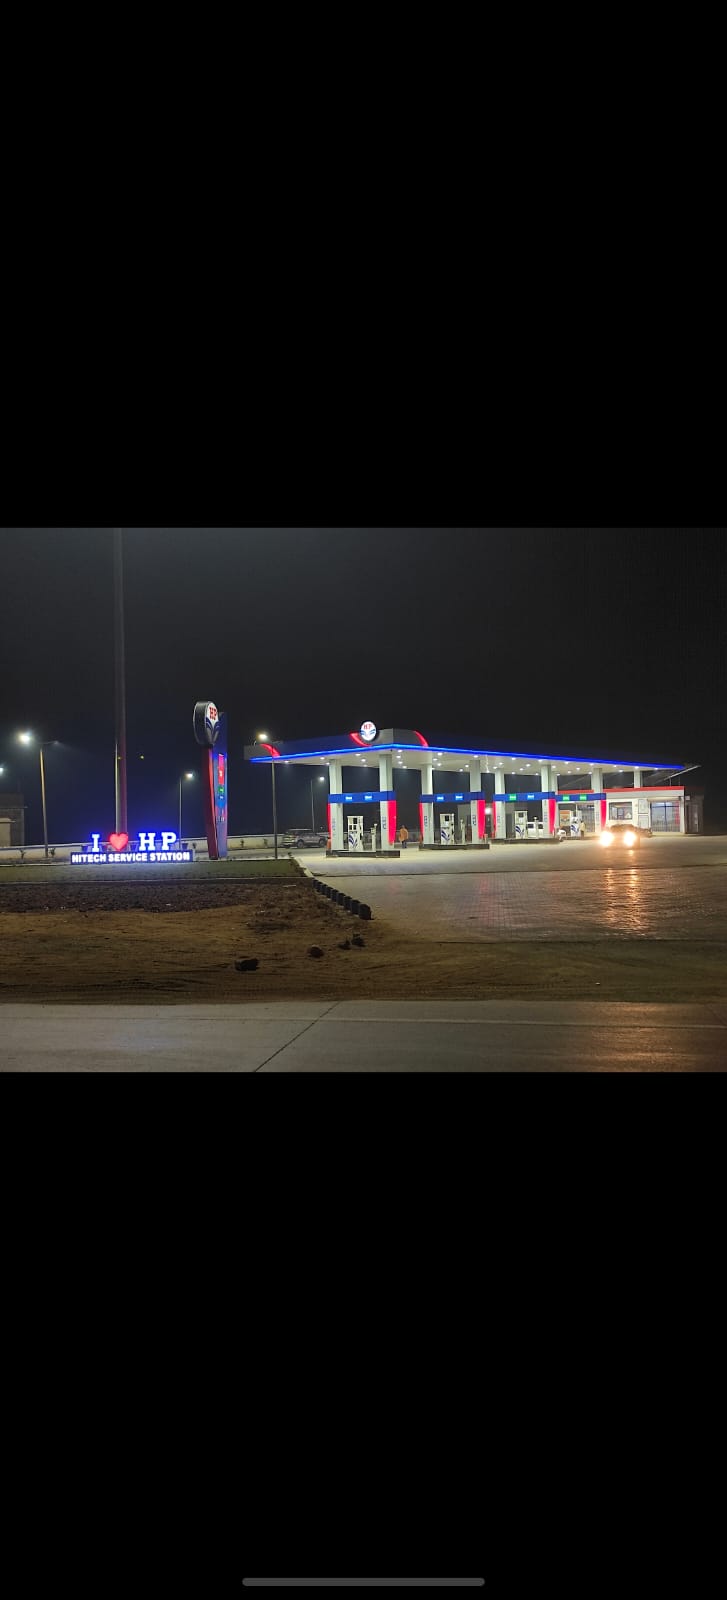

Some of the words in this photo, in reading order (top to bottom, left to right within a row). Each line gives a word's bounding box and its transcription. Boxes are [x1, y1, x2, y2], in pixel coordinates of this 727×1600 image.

[91, 834, 100, 852] I
[108, 853, 148, 862] SERVICE
[149, 852, 190, 862] STATION
